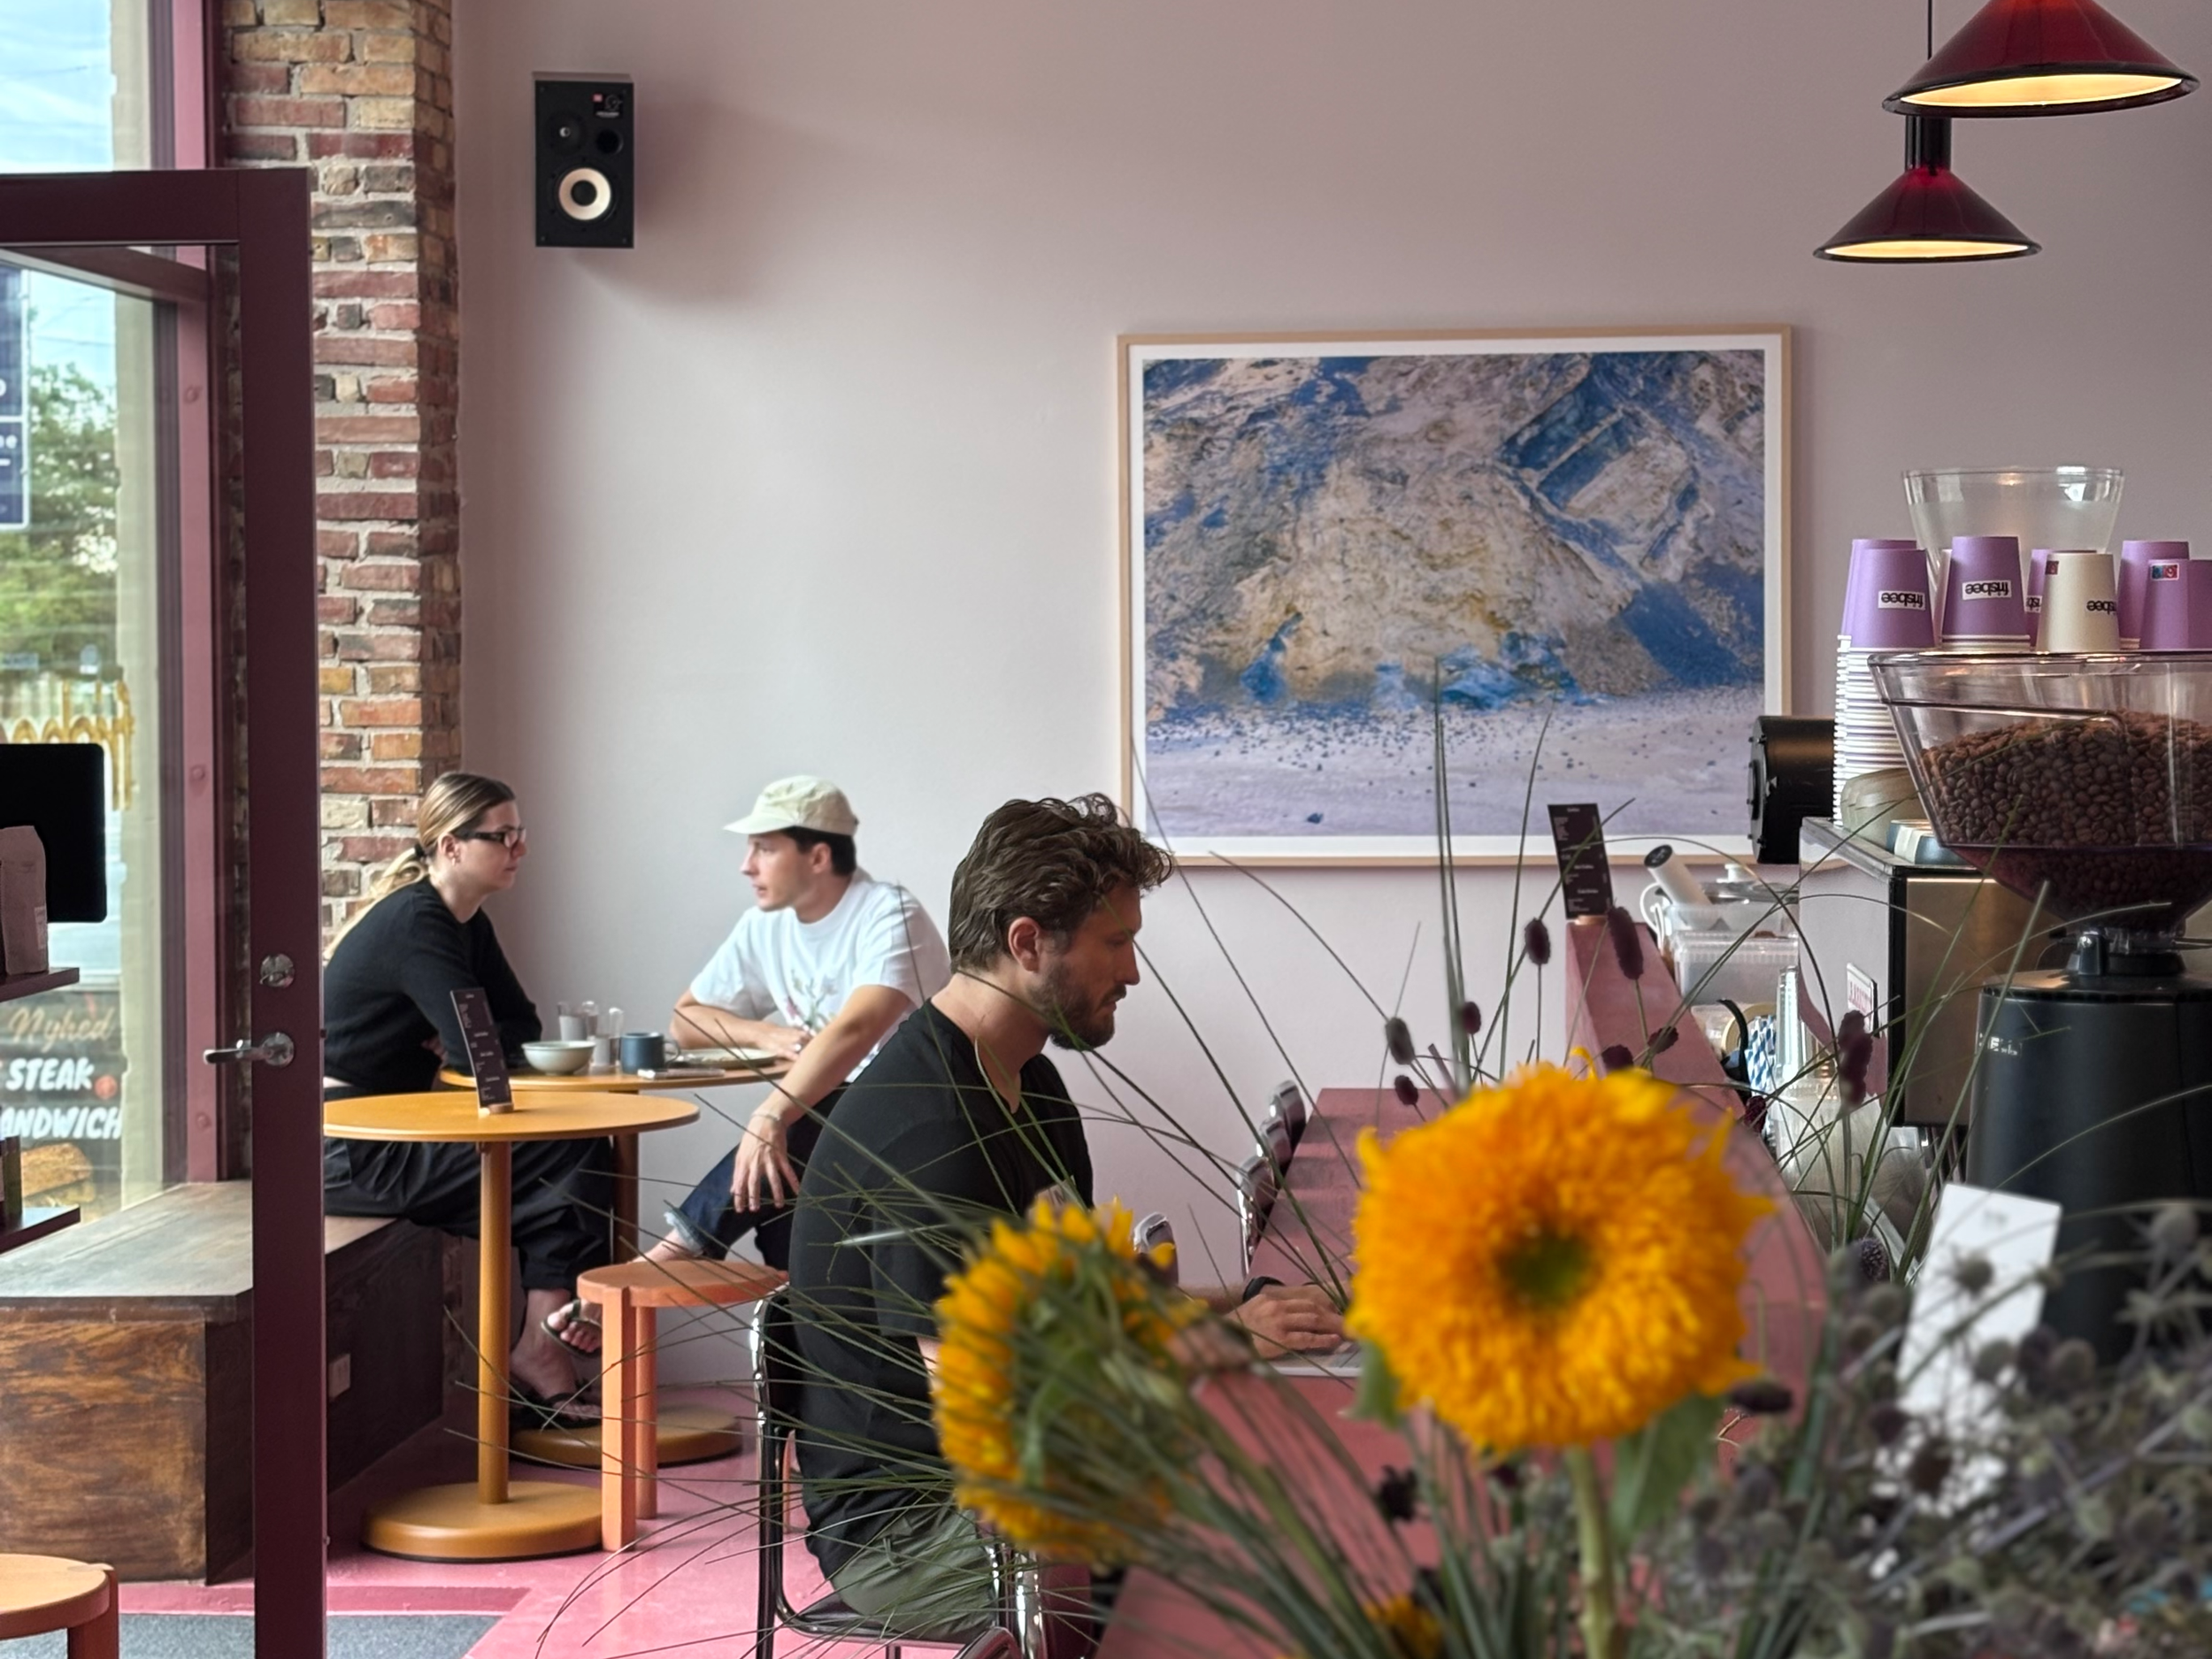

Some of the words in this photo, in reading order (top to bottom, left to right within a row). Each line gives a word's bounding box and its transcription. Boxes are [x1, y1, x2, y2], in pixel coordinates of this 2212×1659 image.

[1881, 592, 1924, 608] frisbee
[1965, 581, 2008, 596] frisbee
[5, 1057, 96, 1091] STEAK
[0, 1107, 122, 1140] ANDWICH
